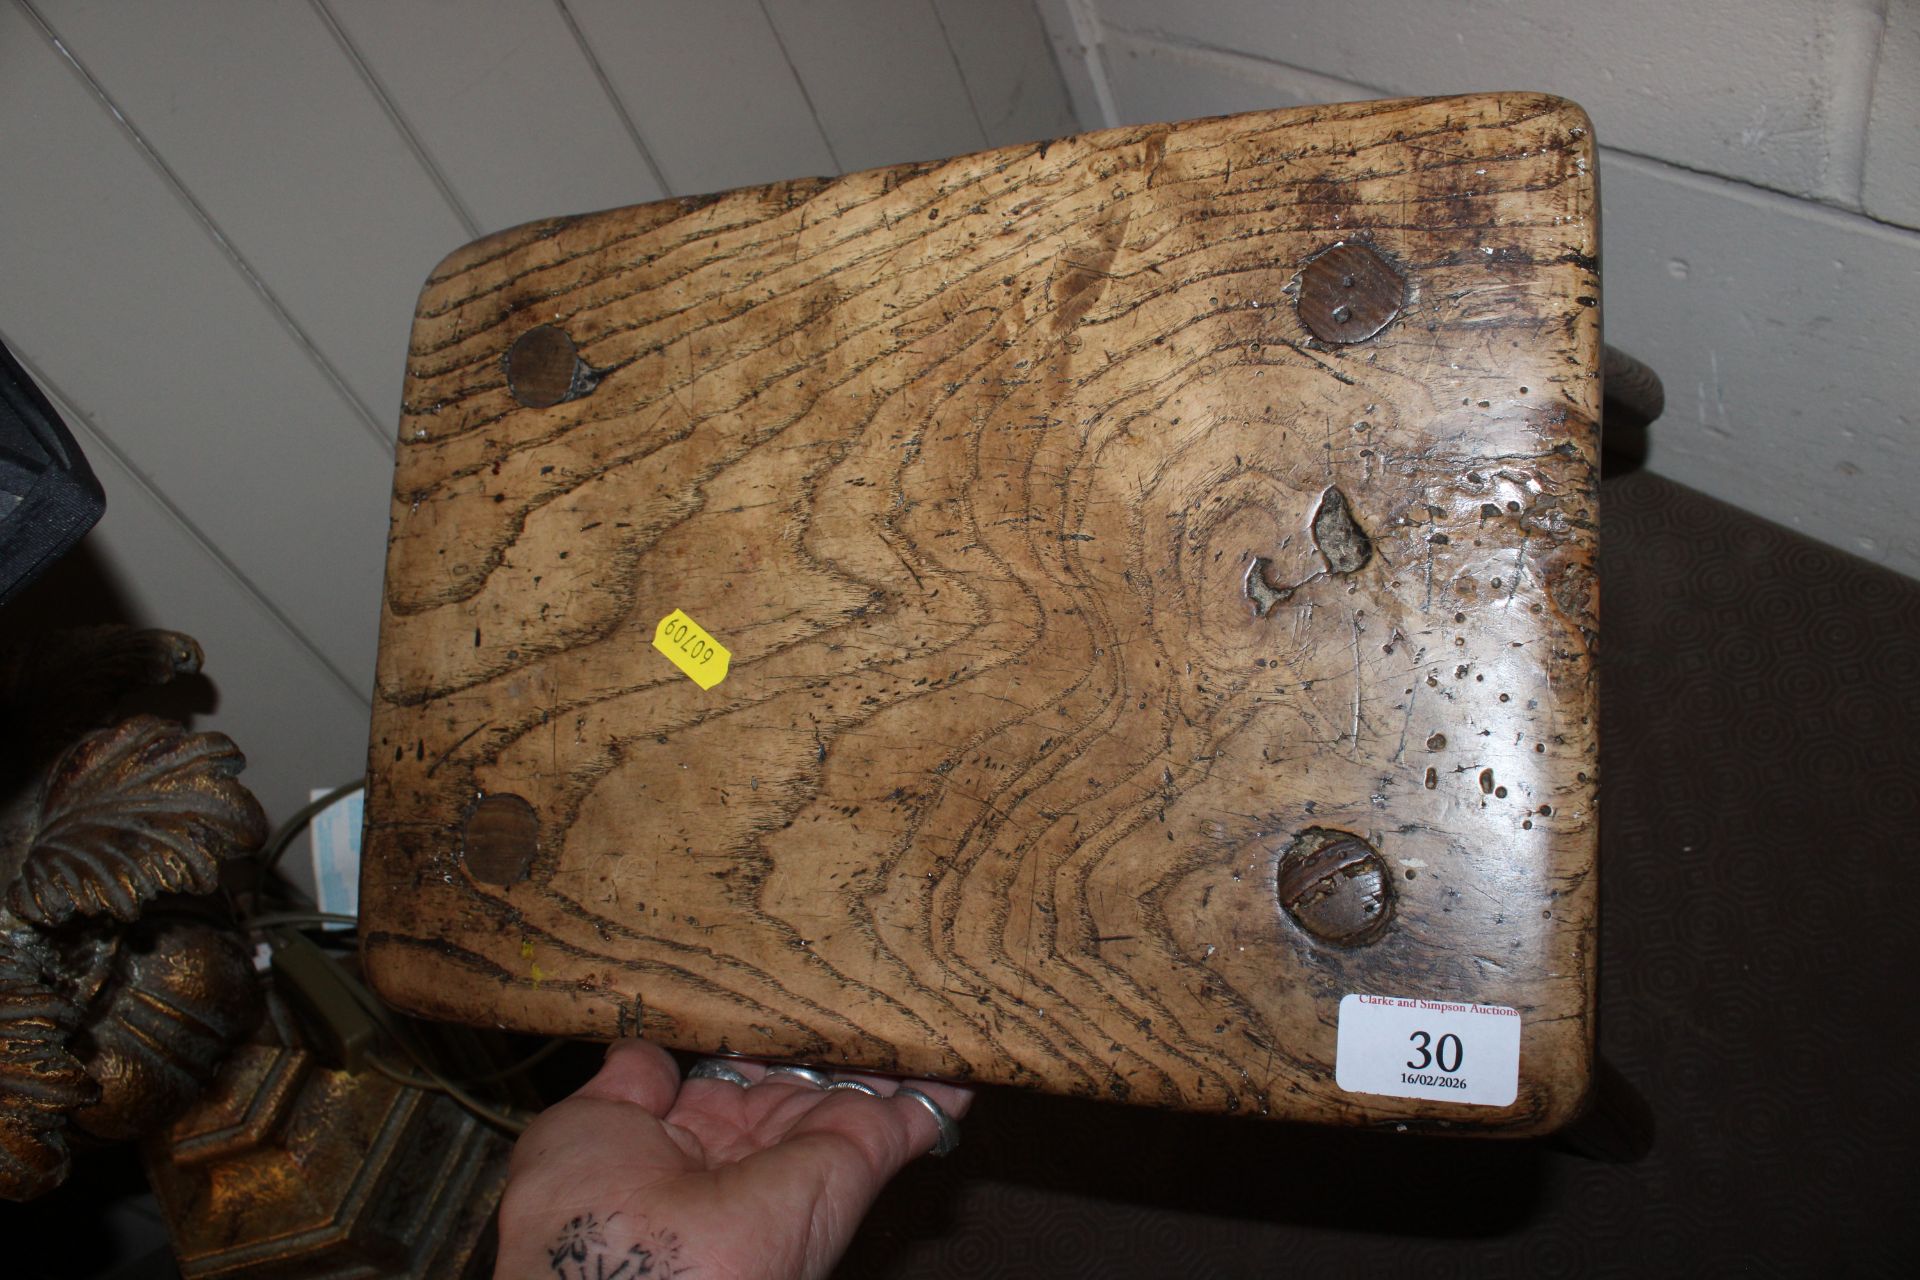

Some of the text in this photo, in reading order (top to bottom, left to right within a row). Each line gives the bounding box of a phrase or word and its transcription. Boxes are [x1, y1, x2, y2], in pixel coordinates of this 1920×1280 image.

[664, 618, 714, 664] 60709
[1359, 994, 1519, 1017] Clarke and Simpson Auctions
[1406, 1031, 1464, 1073] 30
[1401, 1073, 1467, 1090] 16/02/2026
